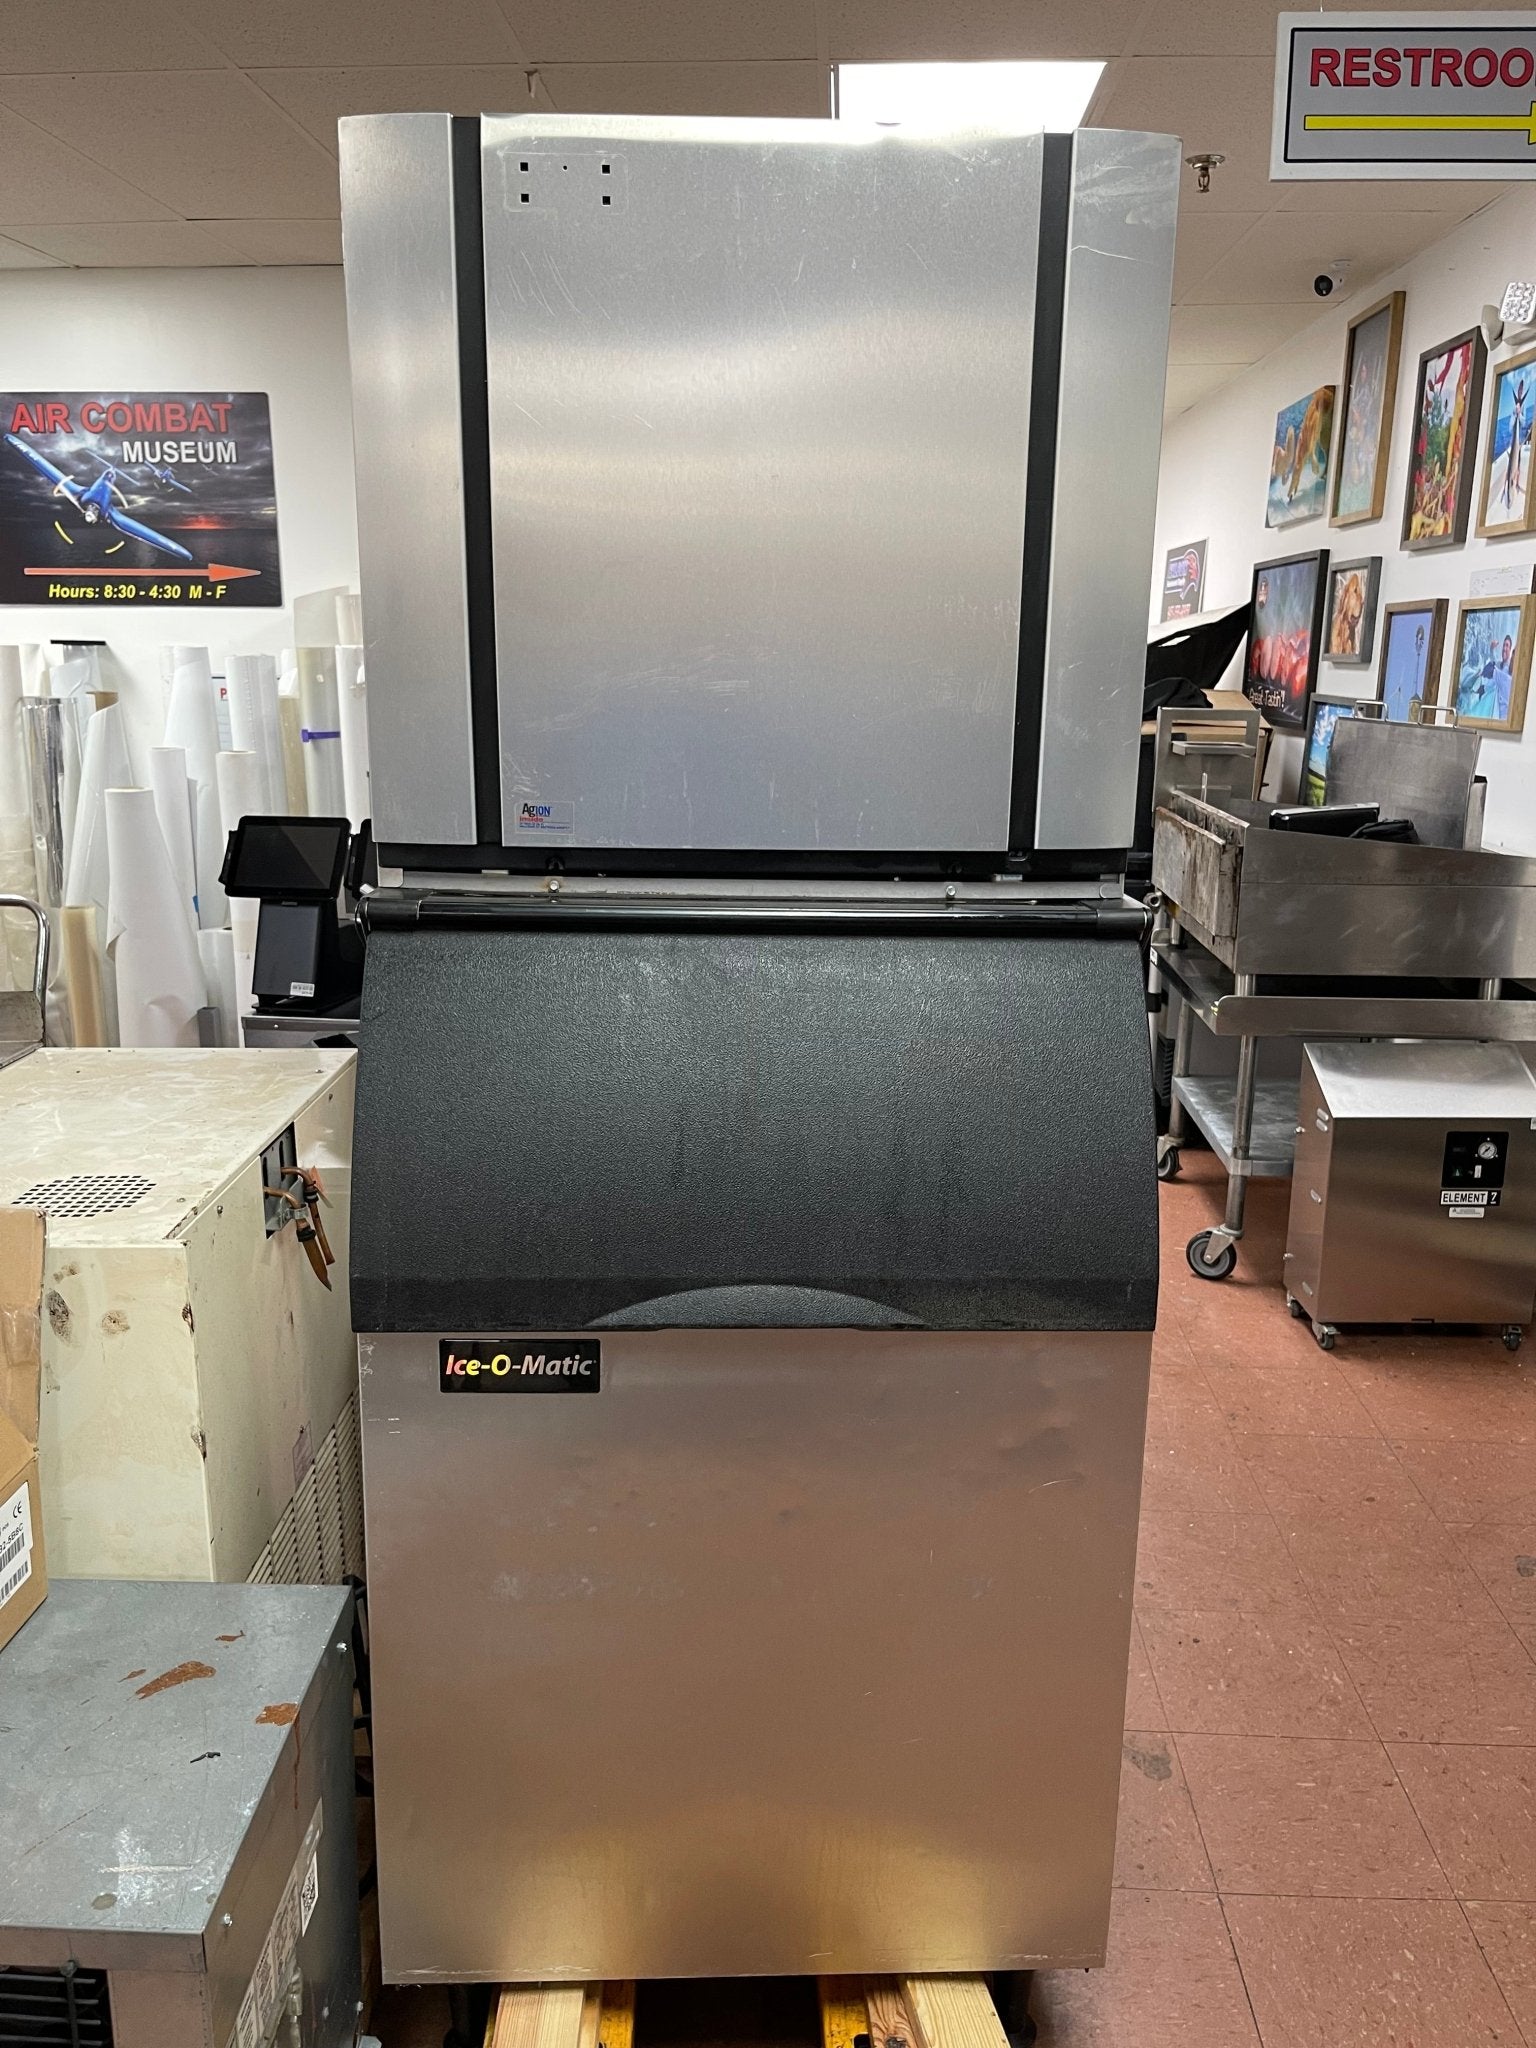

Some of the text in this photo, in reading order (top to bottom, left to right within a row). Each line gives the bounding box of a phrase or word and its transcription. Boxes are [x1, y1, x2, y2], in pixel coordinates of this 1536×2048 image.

[1310, 47, 1536, 87] RESTROO
[11, 402, 233, 434] AIR COMBAT
[122, 441, 237, 464] MUSEUM
[48, 584, 100, 599] Hours:
[103, 584, 136, 599] 8:30
[149, 584, 181, 599] 4:30
[189, 585, 202, 599] M
[215, 585, 227, 599] F
[1442, 1193, 1486, 1203] ELEMENT
[445, 1354, 593, 1376] Ice-O-Matic
